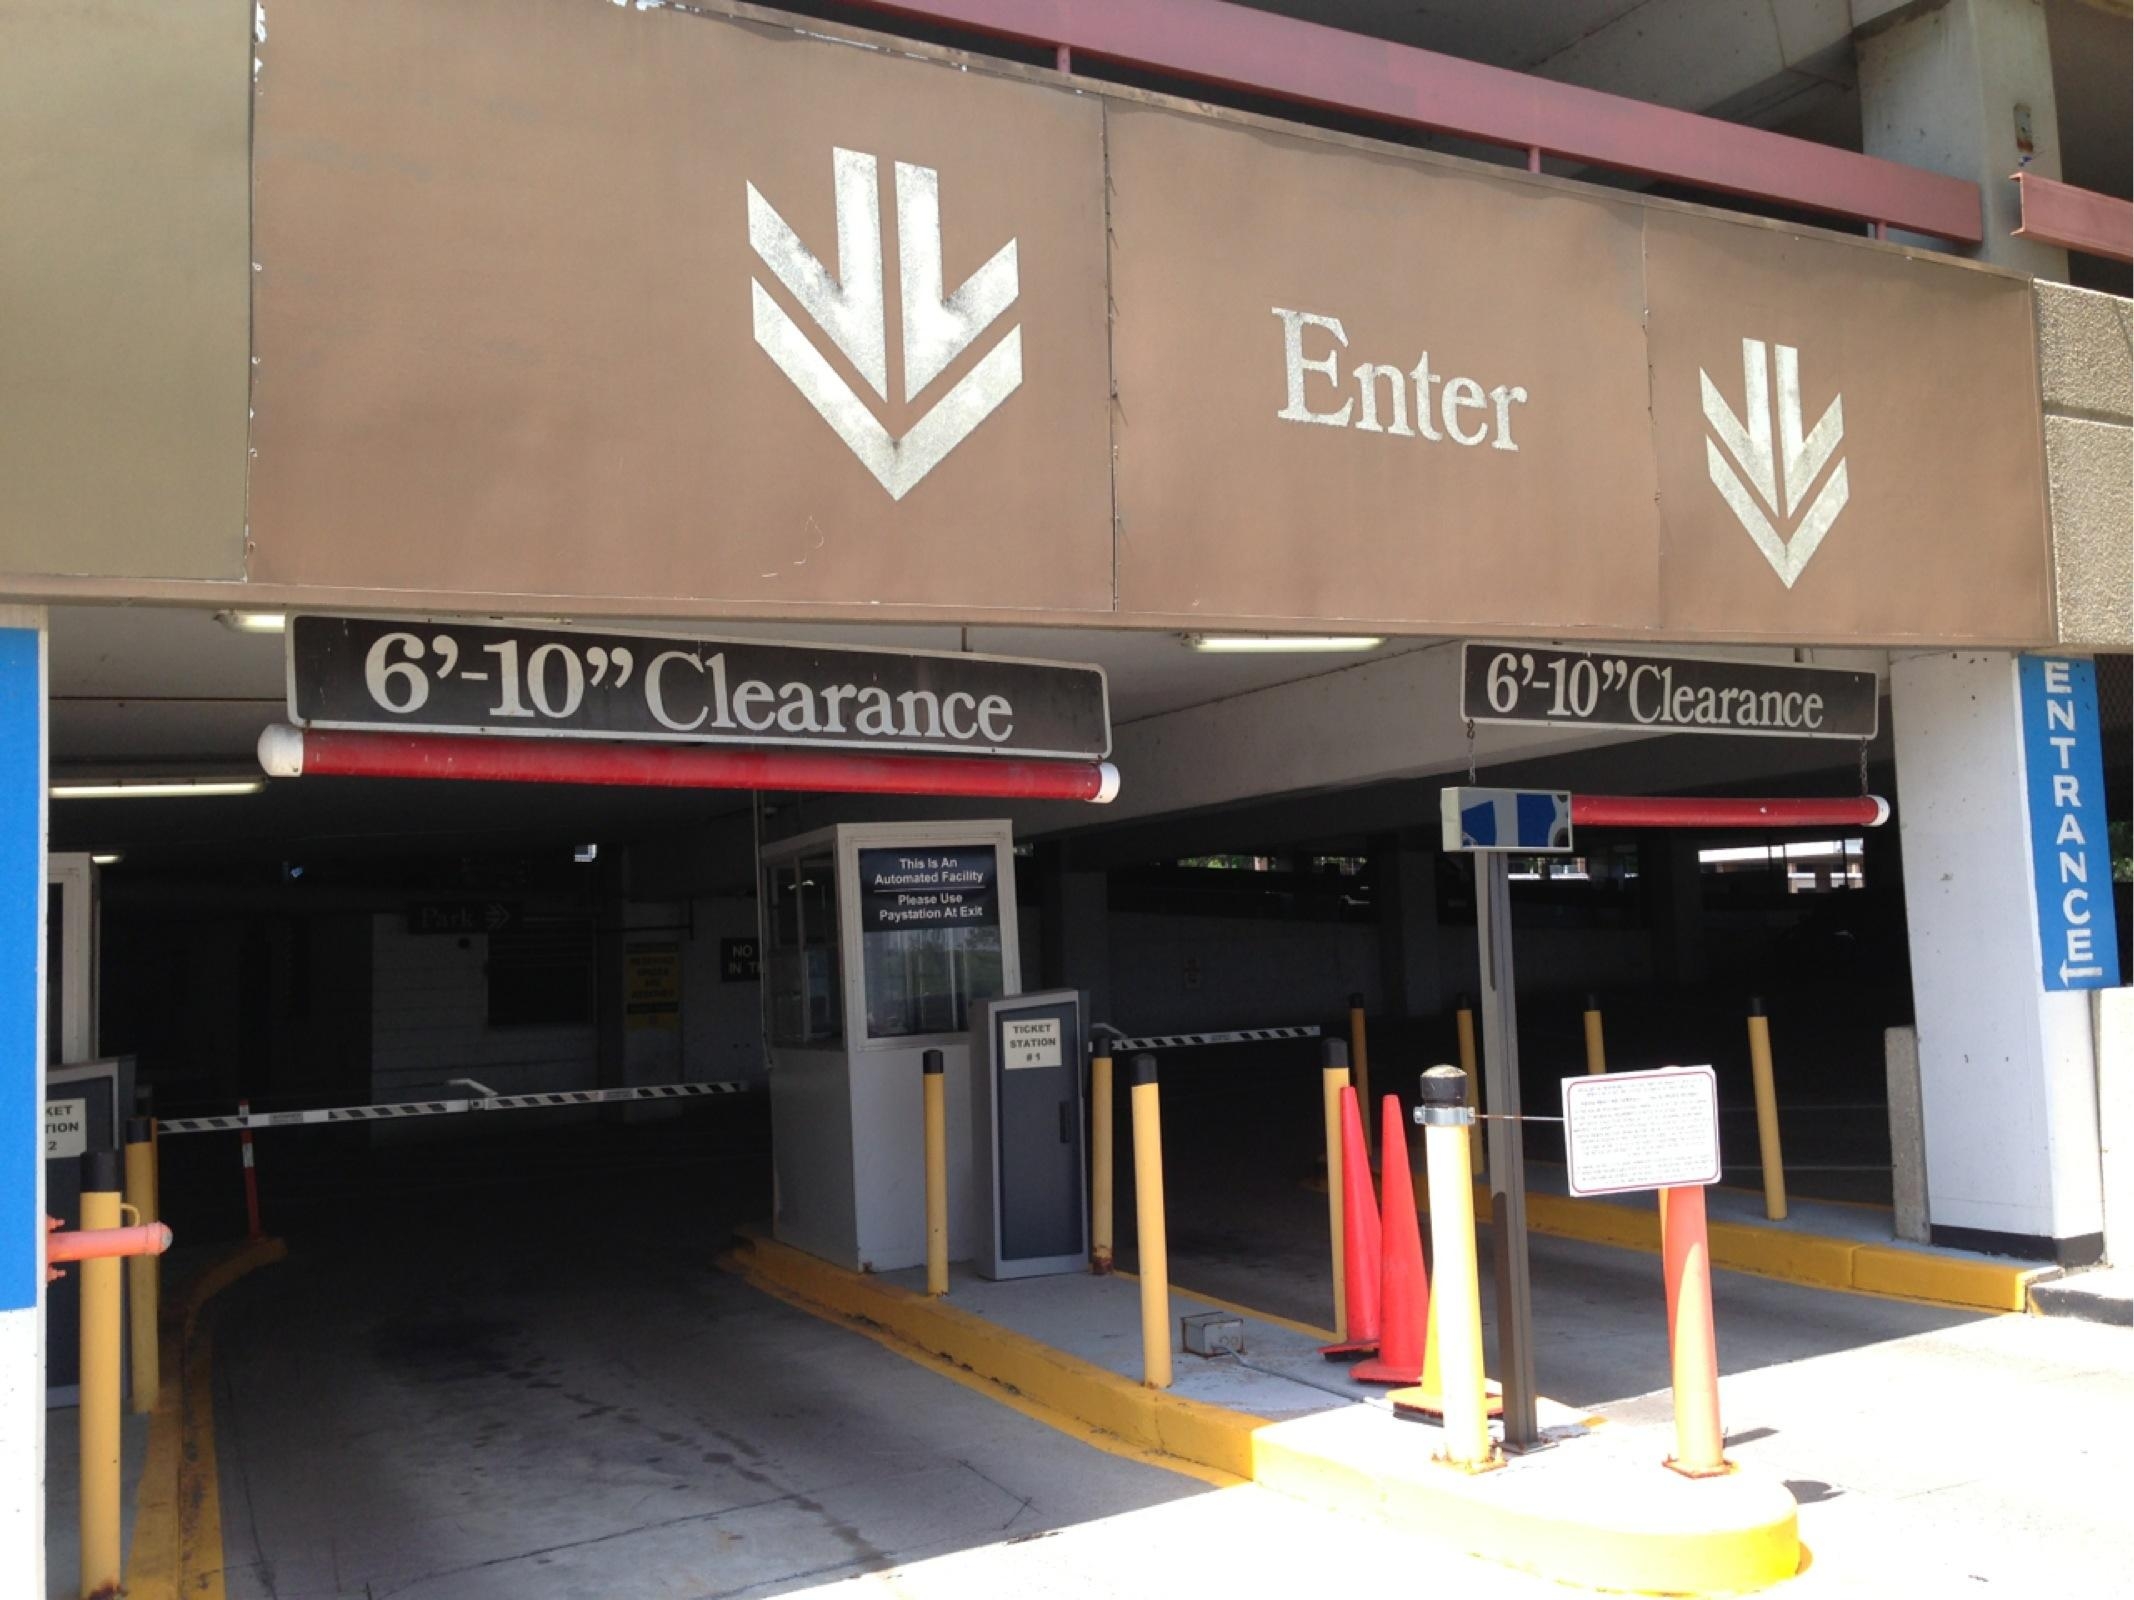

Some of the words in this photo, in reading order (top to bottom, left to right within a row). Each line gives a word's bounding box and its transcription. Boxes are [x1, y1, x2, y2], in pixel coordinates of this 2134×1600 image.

[1271, 306, 1528, 452] Enter
[644, 650, 1015, 742] Clearance
[1629, 664, 1824, 729] Clearance
[2043, 660, 2093, 962] ENTRANCE
[900, 857, 925, 870] This
[942, 857, 958, 868] An
[874, 872, 939, 885] Automated
[942, 869, 984, 884] Facility
[898, 894, 938, 906] Please
[940, 892, 963, 904] Use
[421, 906, 473, 929] Park
[879, 908, 941, 923] Paystation
[944, 906, 958, 918] At
[960, 905, 983, 917] Exit
[732, 943, 753, 959] NO
[1013, 1024, 1052, 1034] TICKET
[1010, 1037, 1056, 1048] STATION
